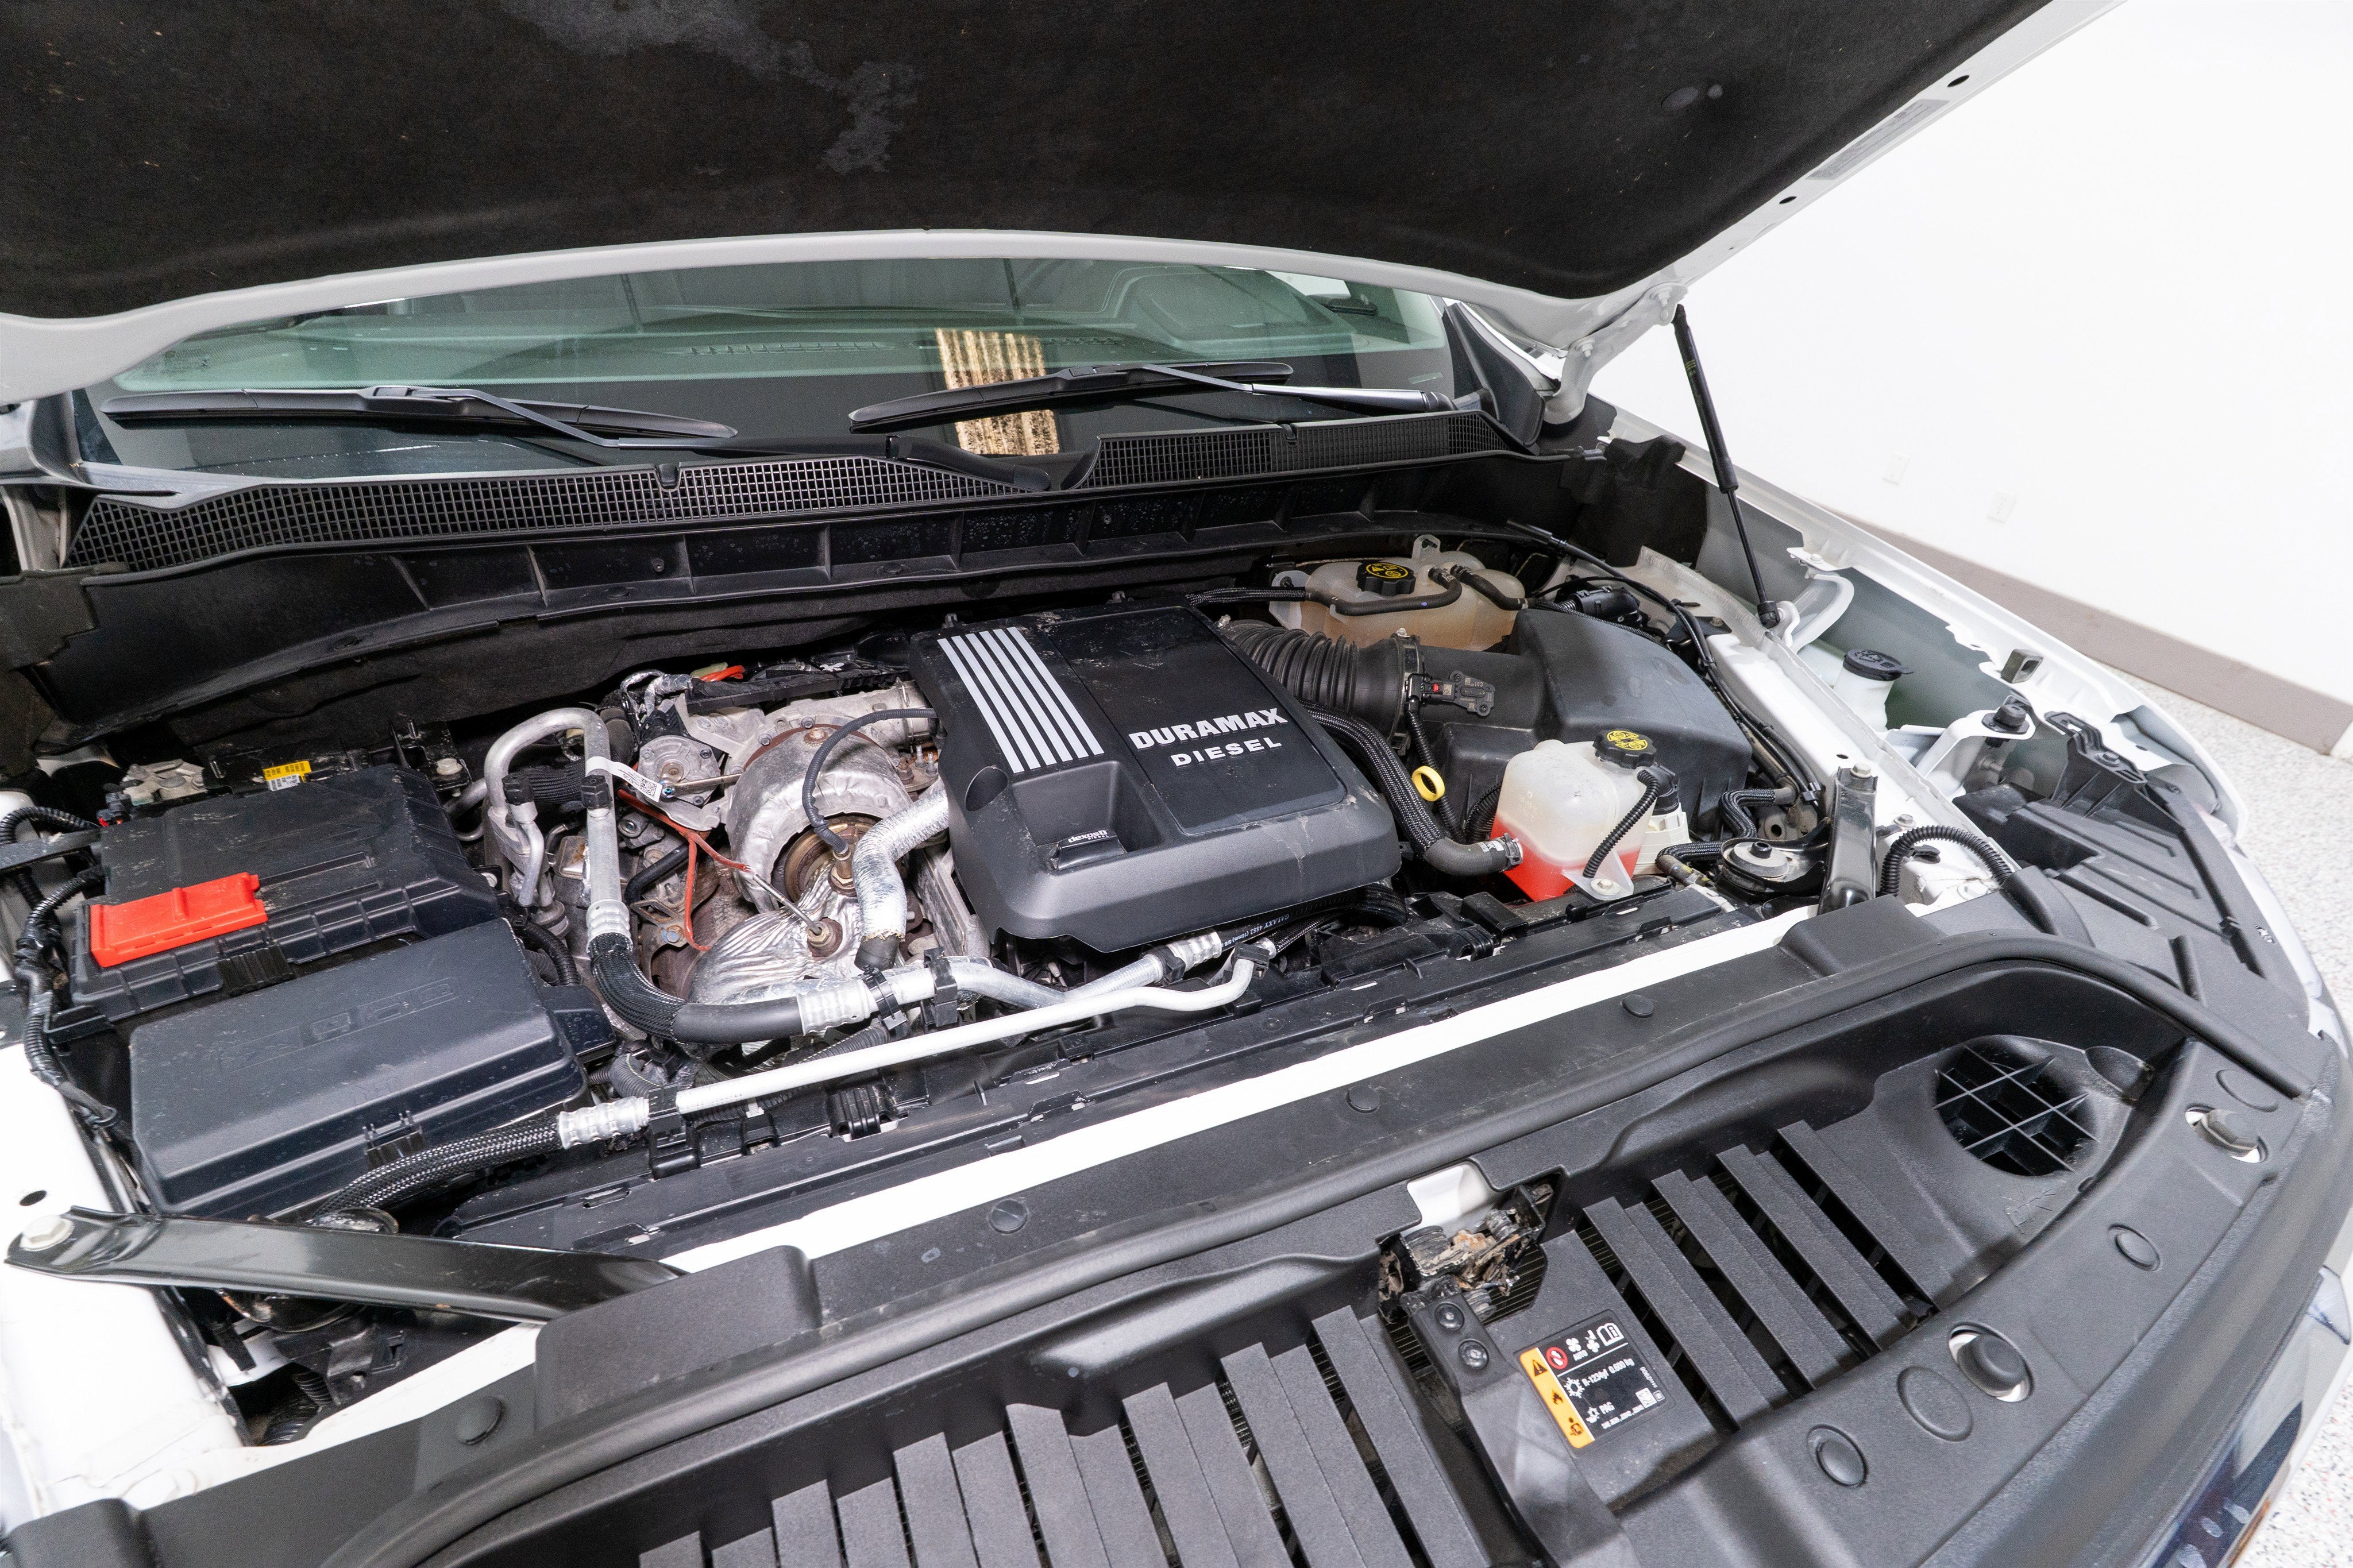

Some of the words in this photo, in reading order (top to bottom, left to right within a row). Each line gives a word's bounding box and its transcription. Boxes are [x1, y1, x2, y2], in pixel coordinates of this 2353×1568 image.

[1128, 708, 1288, 750] DURAMAX
[1170, 737, 1282, 767] DIESEL
[1264, 914, 1290, 929] GALAXY
[1232, 930, 1249, 943] (16mm)
[1250, 925, 1263, 934] 4882
[1599, 1401, 1615, 1415] PAG
